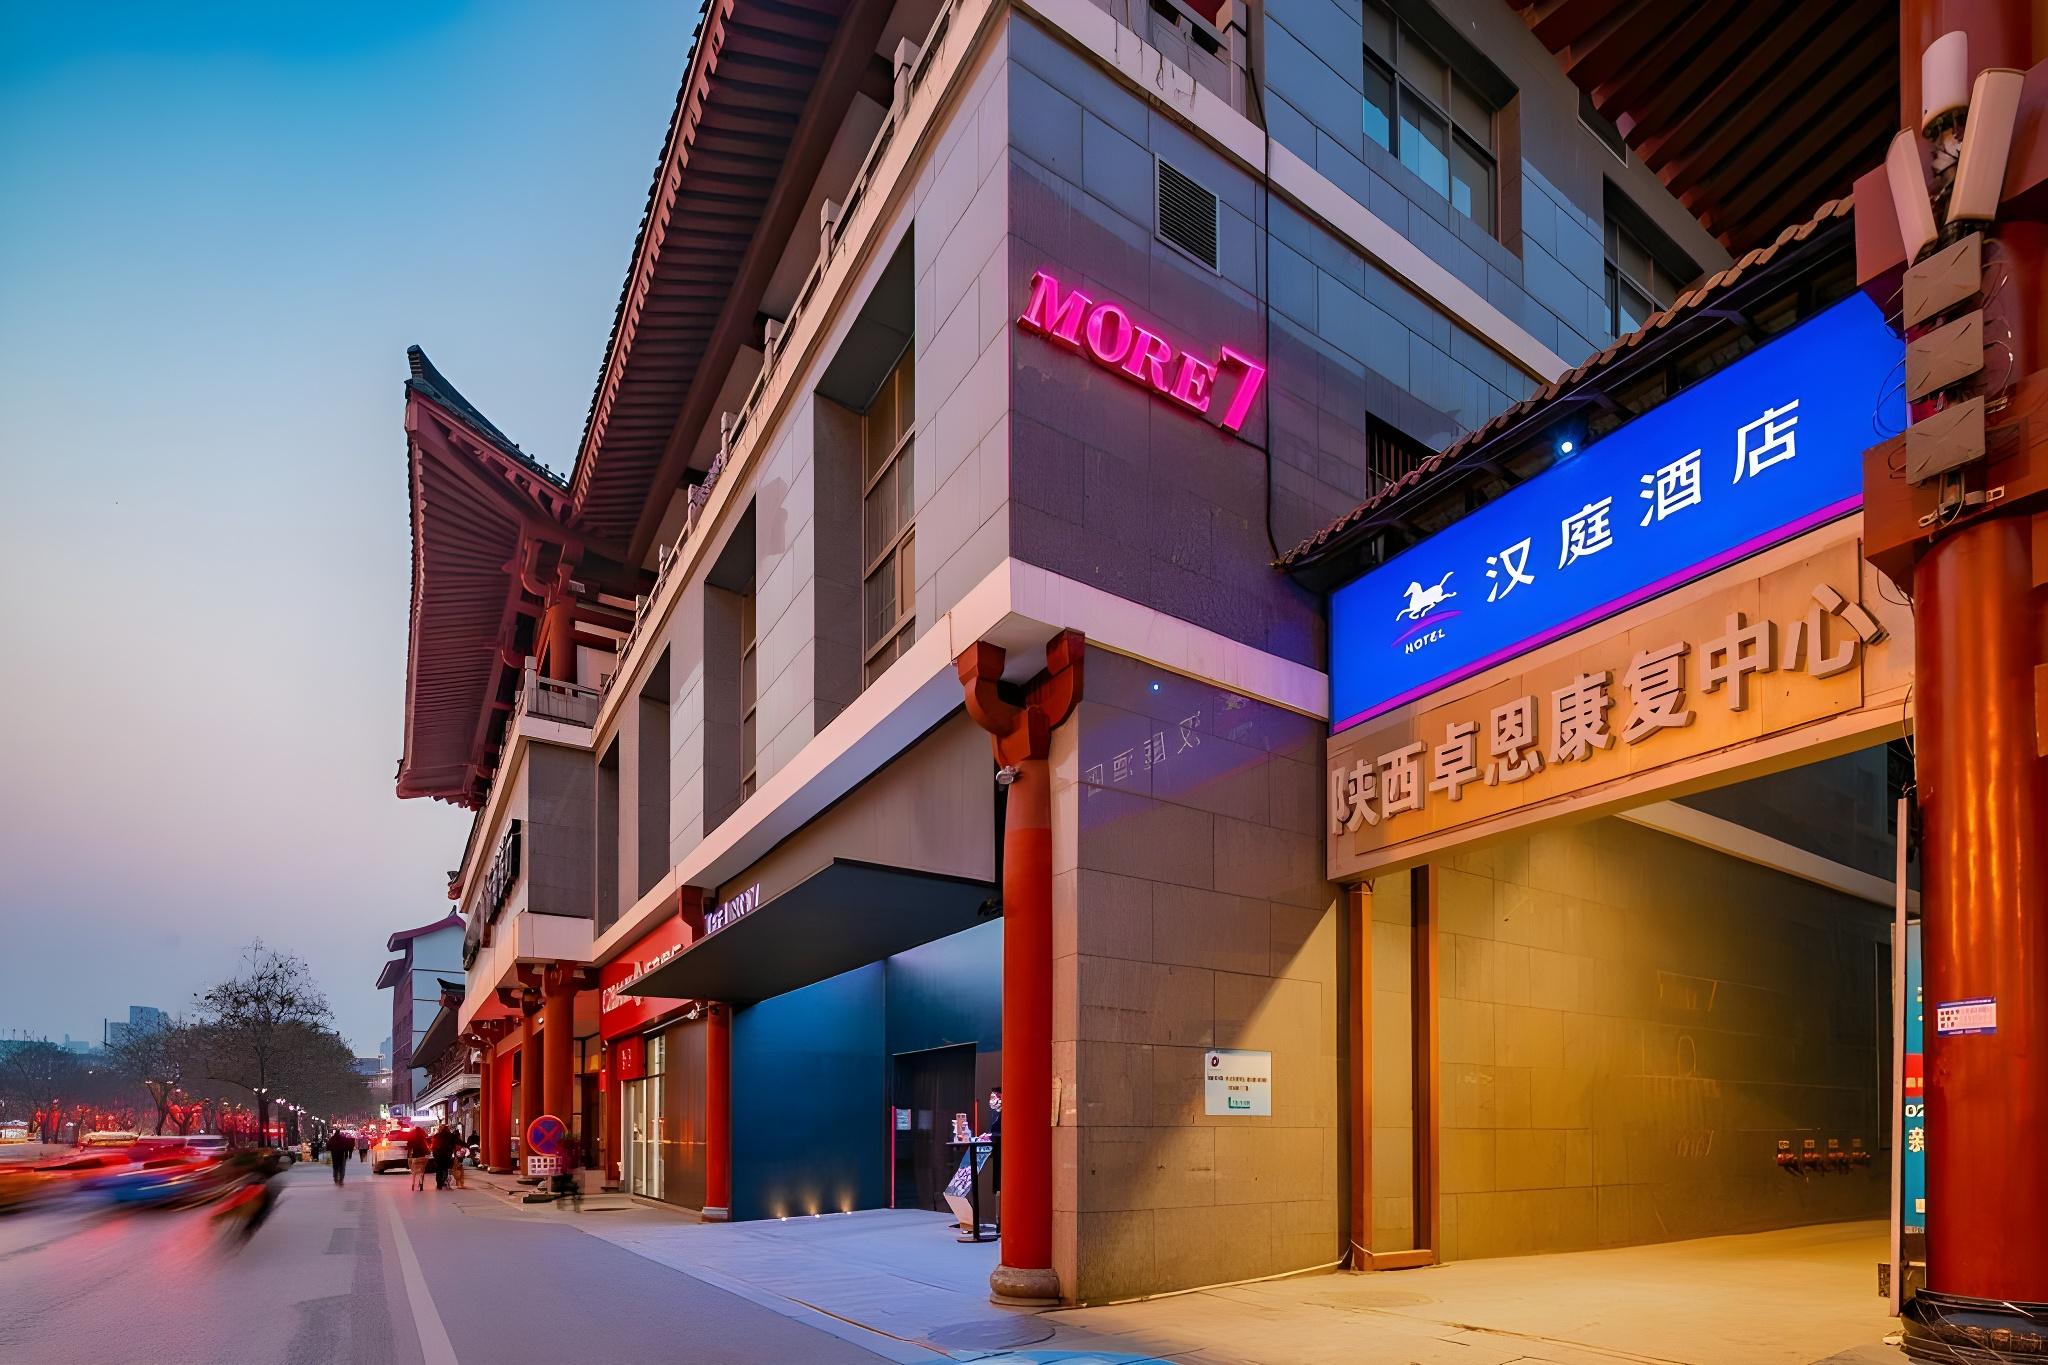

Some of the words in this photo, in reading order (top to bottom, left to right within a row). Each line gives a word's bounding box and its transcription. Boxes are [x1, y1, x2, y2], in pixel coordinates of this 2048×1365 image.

[1485, 397, 1800, 603] 汉庭酒店
[1330, 583, 1888, 837] 陕西卓恩康复中心
[1404, 628, 1446, 655] HOTEL
